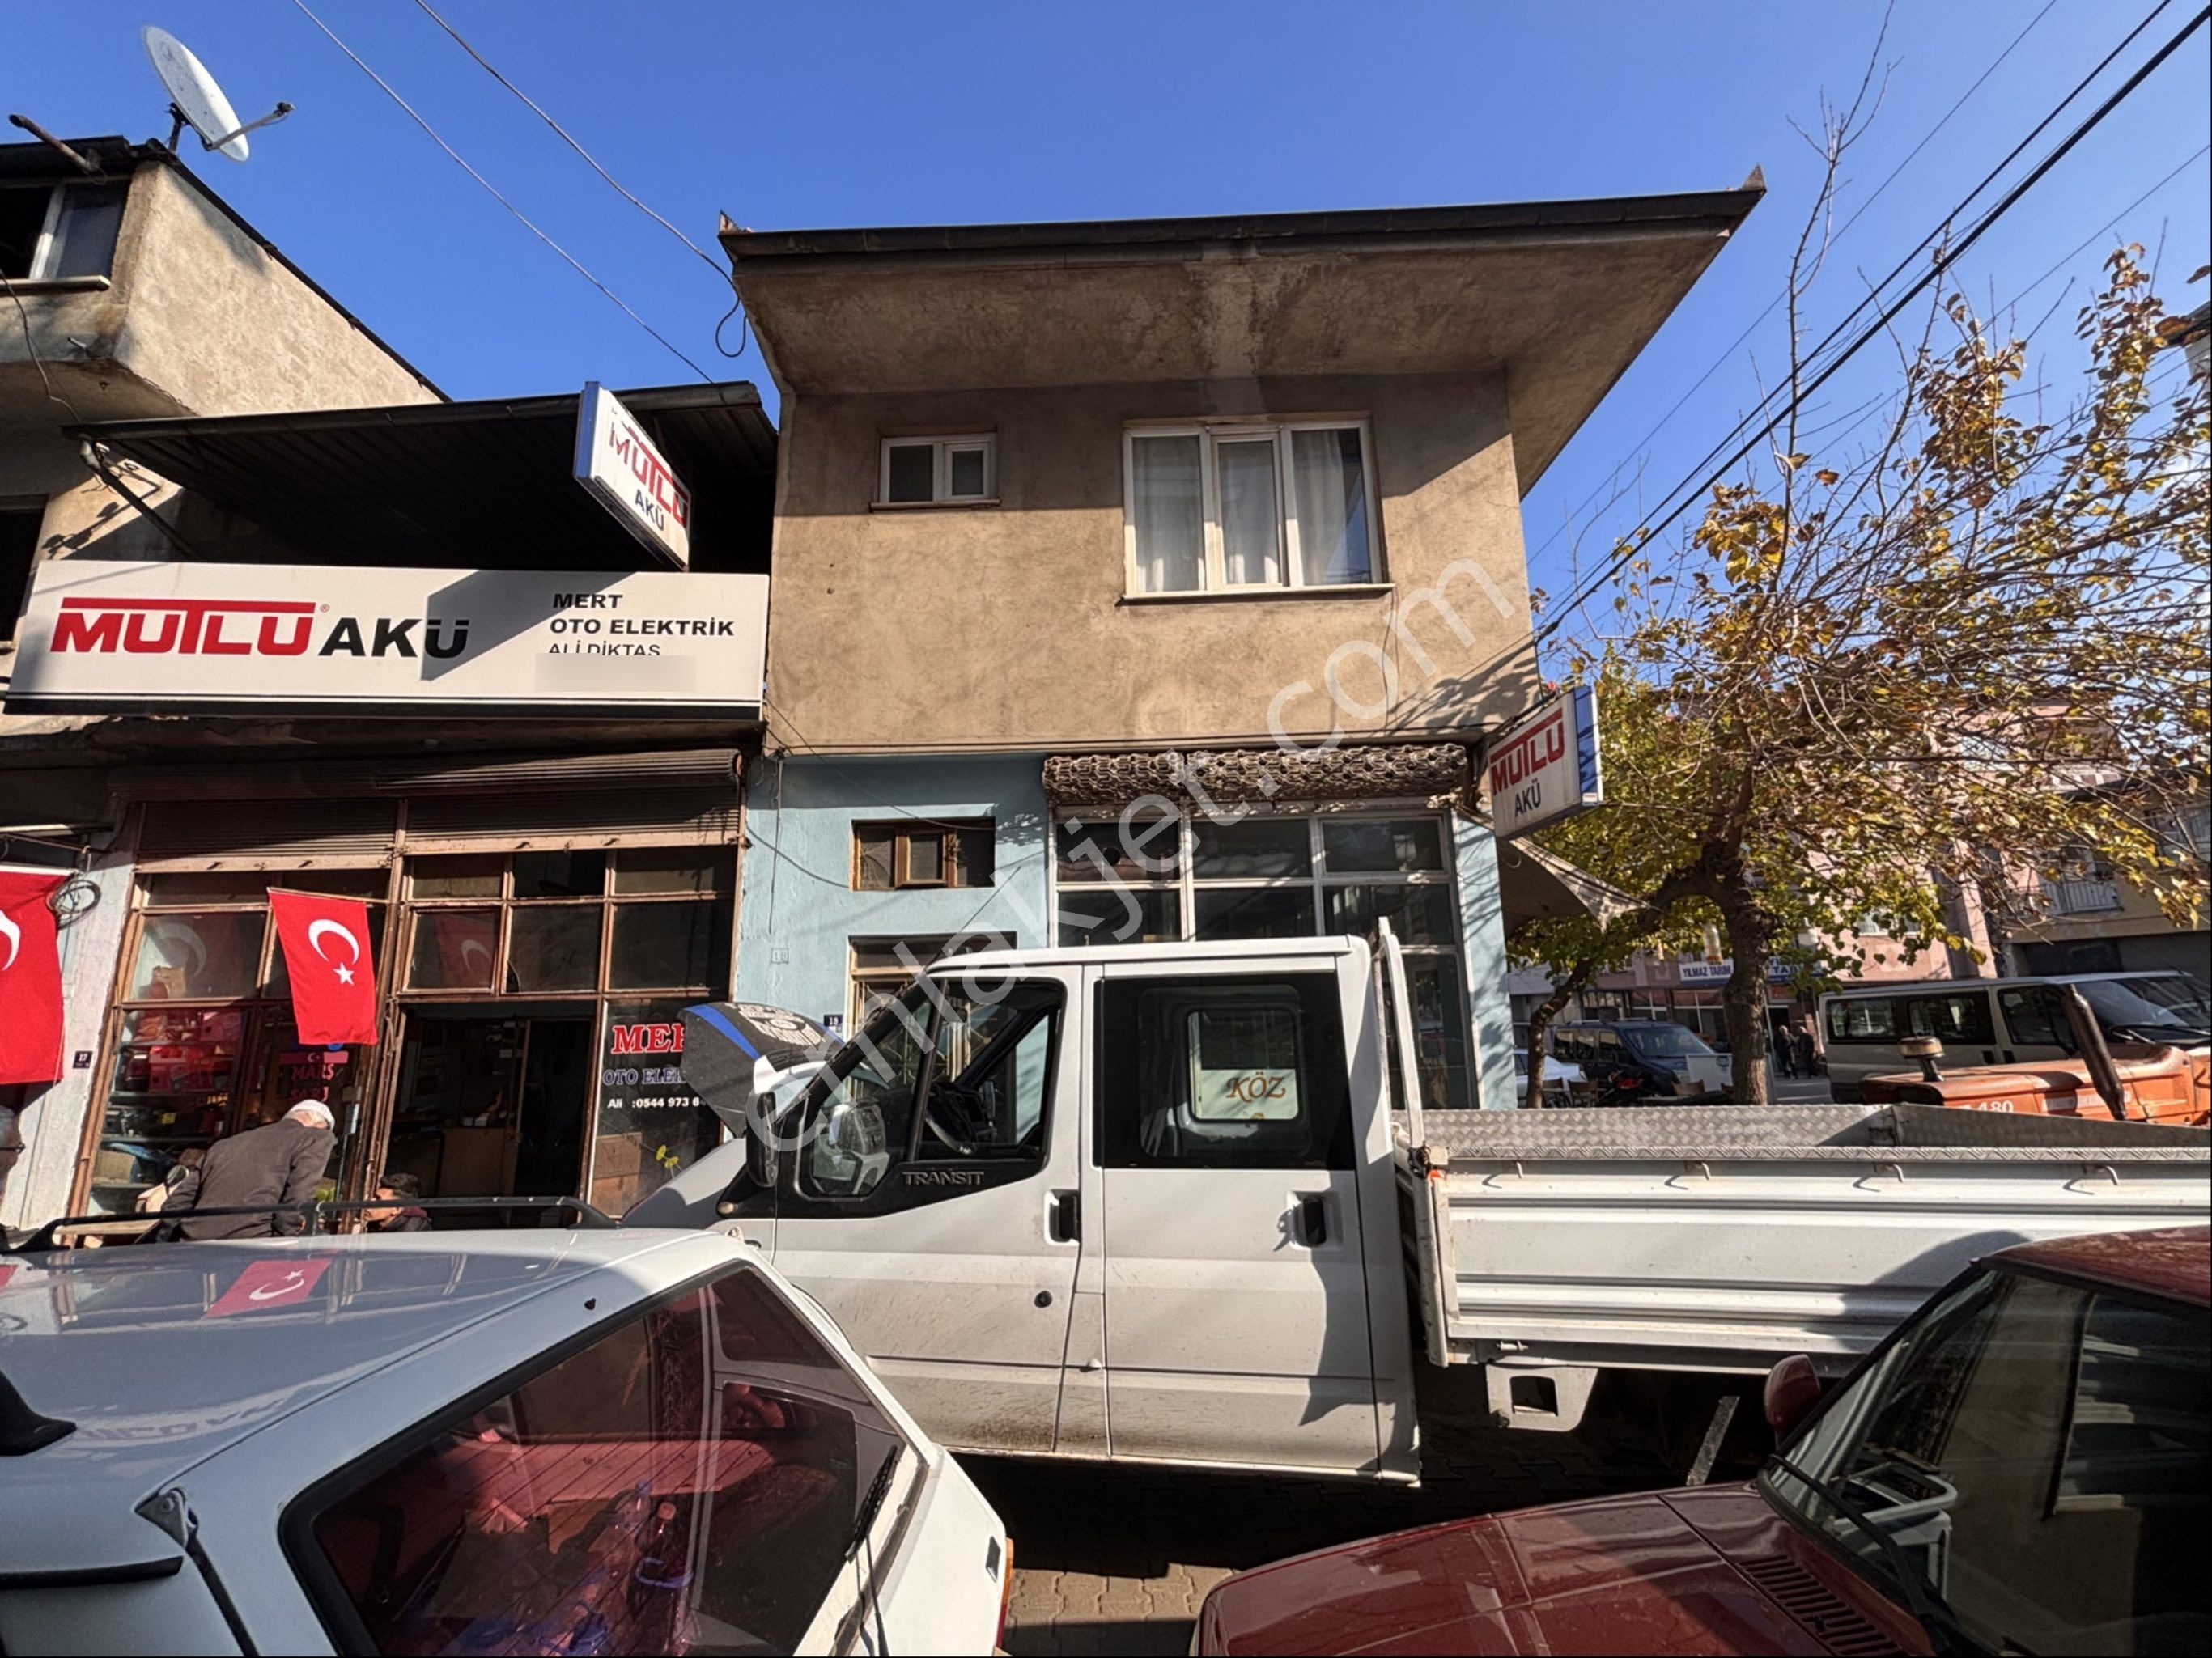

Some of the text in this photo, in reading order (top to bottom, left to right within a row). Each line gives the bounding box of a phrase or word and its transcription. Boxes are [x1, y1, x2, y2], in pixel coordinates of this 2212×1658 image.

[609, 422, 689, 531] MUTLU
[635, 488, 664, 532] AKÜ
[553, 593, 623, 608] MERT
[50, 596, 469, 659] MUTLU AKÜ
[550, 617, 735, 637] OTO ELEKTRİK
[1489, 706, 1566, 797] MUTLU
[1514, 778, 1542, 817] AKÜ
[603, 1069, 639, 1086] OTO
[1225, 1071, 1287, 1104] KÖZ
[607, 1098, 623, 1109] Ali
[668, 1096, 690, 1108] 973
[902, 1171, 985, 1185] TRANSIT
